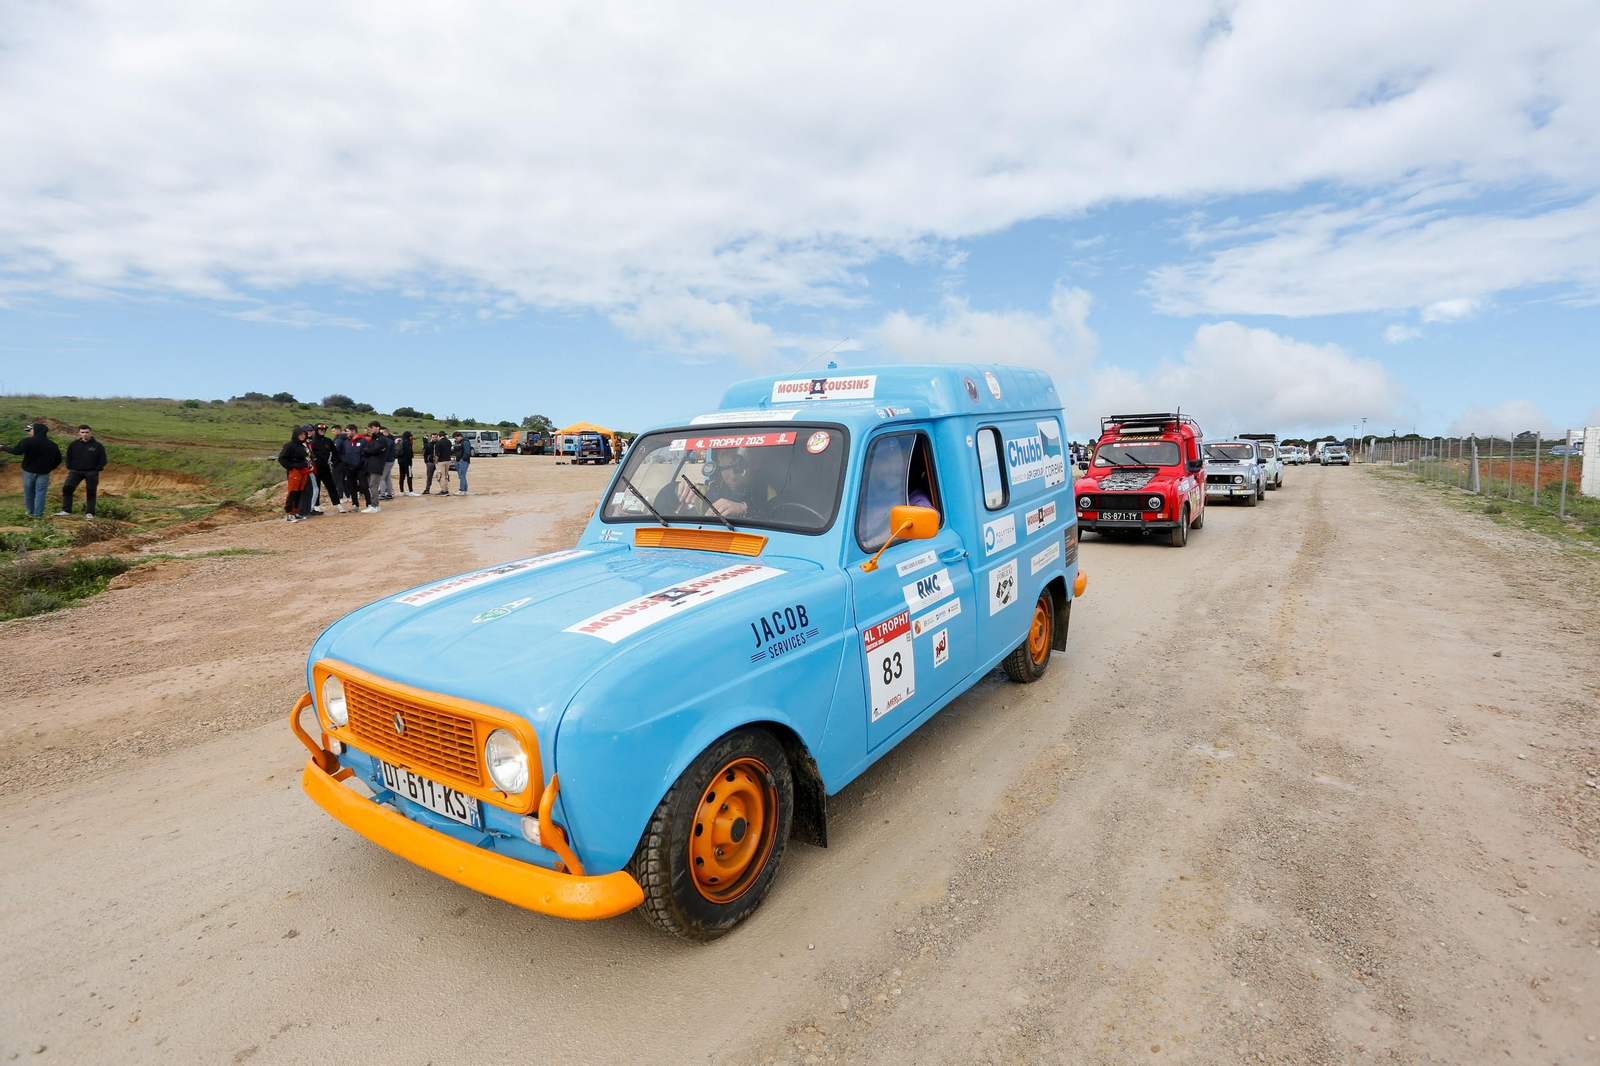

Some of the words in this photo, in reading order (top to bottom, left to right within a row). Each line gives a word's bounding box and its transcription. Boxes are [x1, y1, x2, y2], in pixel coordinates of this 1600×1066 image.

[777, 381, 814, 394] MOUSSE
[814, 382, 823, 391] &
[822, 379, 870, 391] COUSSINS
[695, 438, 705, 448] 4L
[709, 437, 743, 448] TROPHY
[746, 435, 765, 445] 2025
[1008, 437, 1042, 467] Chubb
[996, 527, 1015, 538] POLYTECH
[578, 596, 668, 634] MOUSSE
[679, 565, 763, 593] COUSSINS
[917, 573, 941, 599] RMC
[751, 604, 810, 648] JACOB
[864, 631, 876, 643] 4L
[877, 612, 909, 637] TROPHY
[768, 632, 807, 659] SERVICES
[883, 651, 903, 685] 83
[383, 762, 467, 820] DT-611-KS
[470, 810, 481, 828] 71
